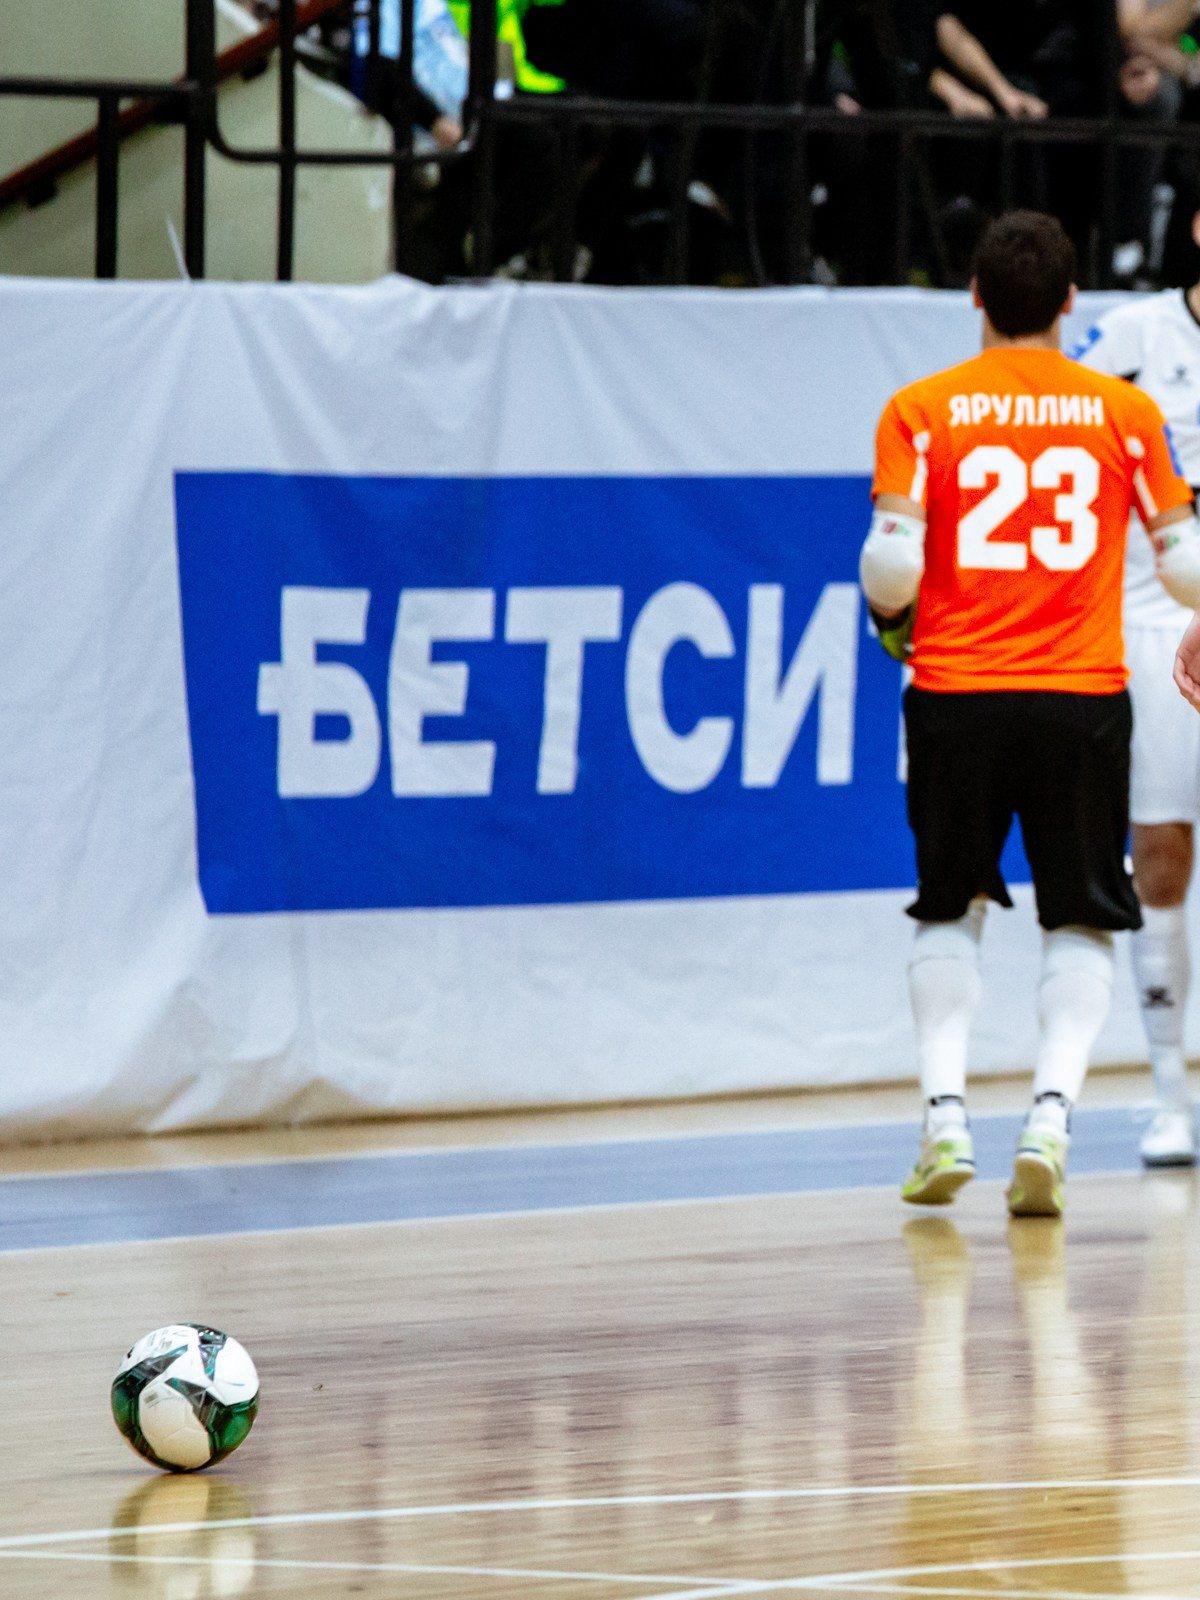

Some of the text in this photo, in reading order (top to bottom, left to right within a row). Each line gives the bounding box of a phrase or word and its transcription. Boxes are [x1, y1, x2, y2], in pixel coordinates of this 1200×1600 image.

[949, 393, 1104, 426] ЯРУЛЛИН
[958, 446, 1100, 571] 23
[257, 580, 908, 802] БЕТСИ
